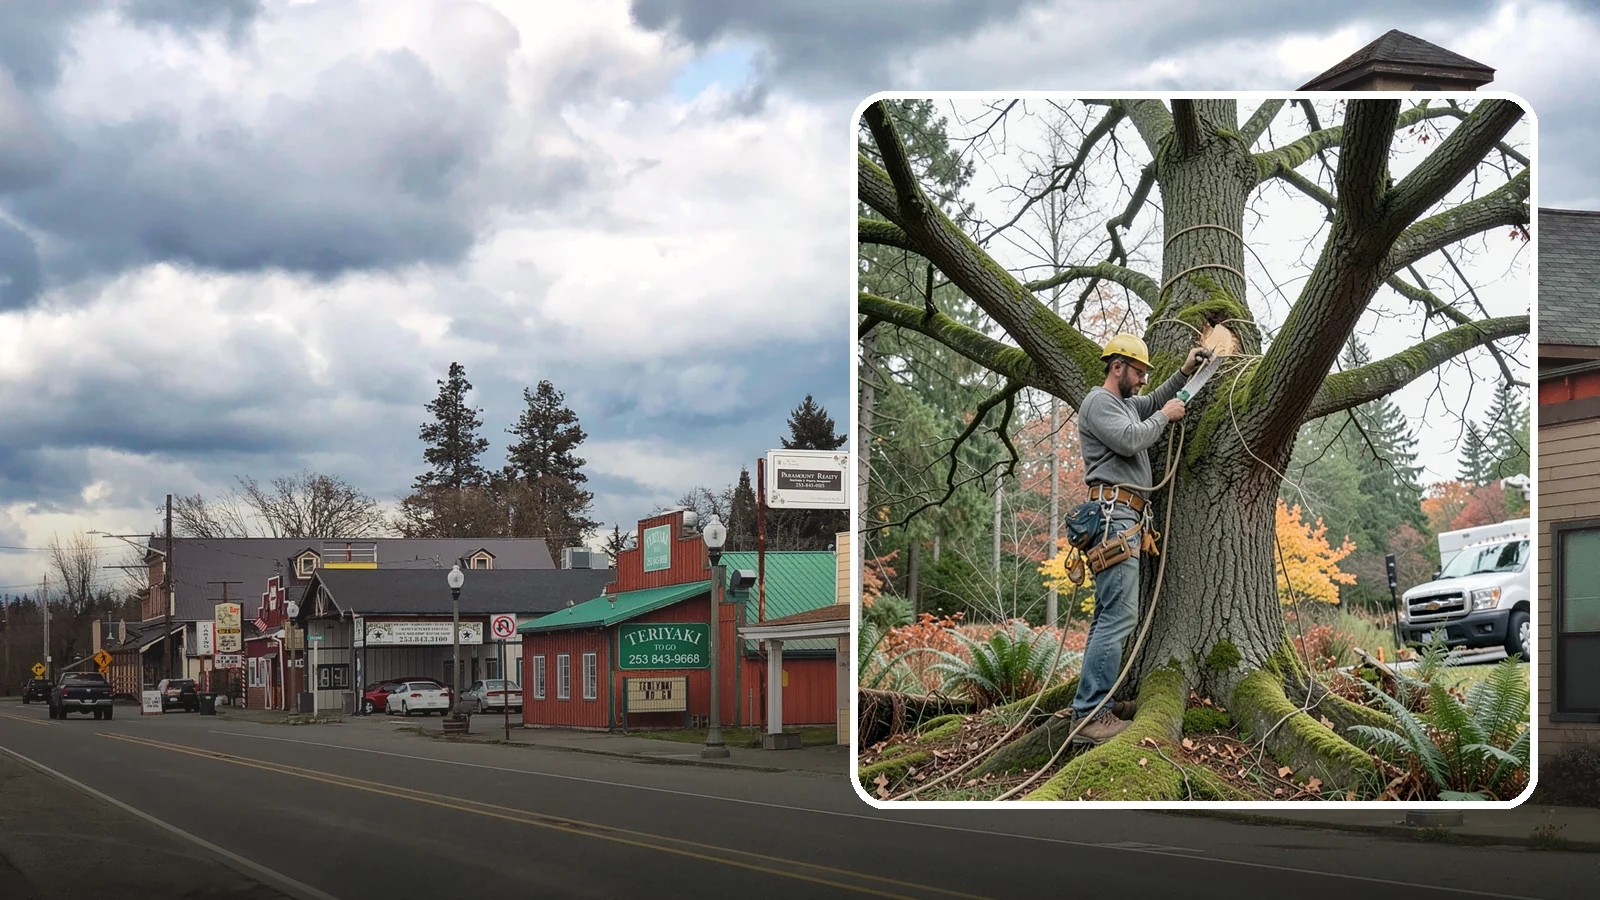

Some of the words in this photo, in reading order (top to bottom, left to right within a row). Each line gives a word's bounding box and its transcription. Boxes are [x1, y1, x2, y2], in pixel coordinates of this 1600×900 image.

[624, 627, 702, 646] TERIYAKI
[653, 643, 665, 651] TO
[665, 643, 677, 651] GO
[628, 654, 649, 665] 253
[651, 653, 700, 664] 843-9668
[639, 681, 672, 691] TERIYAKI
